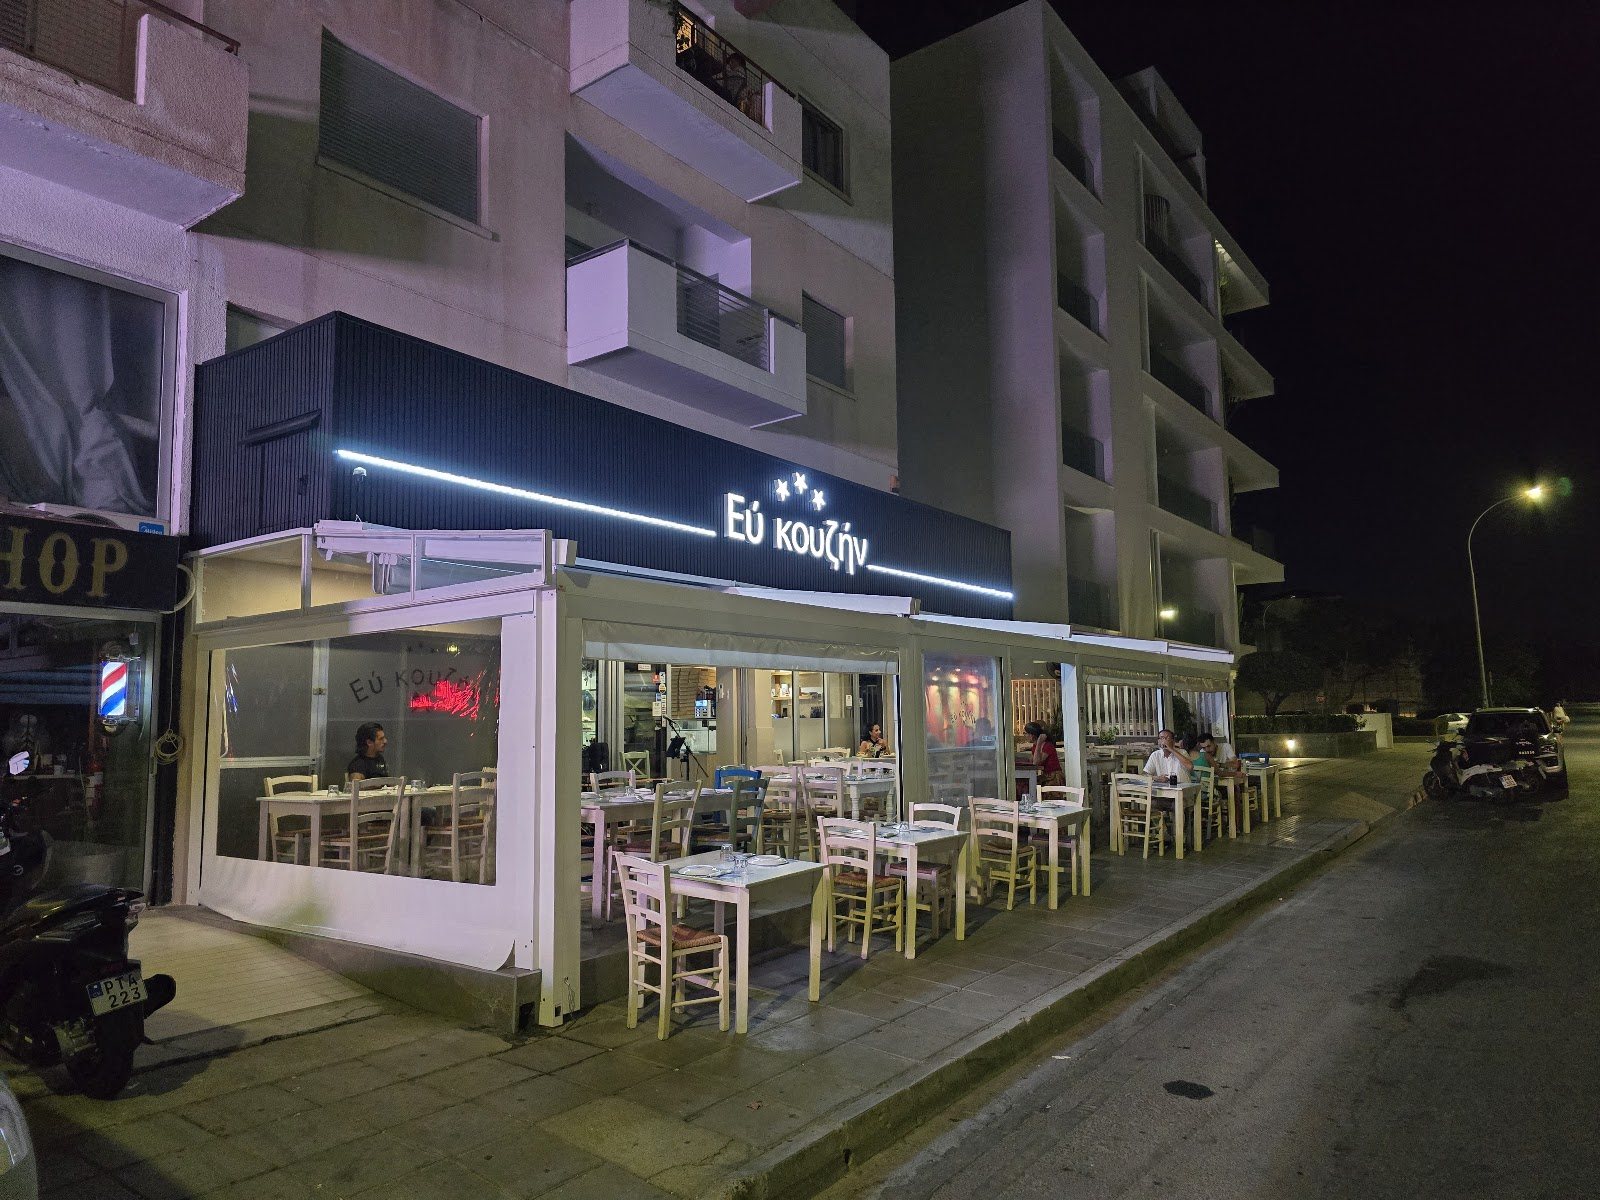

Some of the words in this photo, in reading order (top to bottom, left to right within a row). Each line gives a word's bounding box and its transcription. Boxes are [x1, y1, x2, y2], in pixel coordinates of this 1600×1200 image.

[724, 492, 764, 544] Εύ
[773, 517, 868, 575] κουζήν
[103, 973, 138, 994] PTA
[108, 987, 141, 1008] 223
